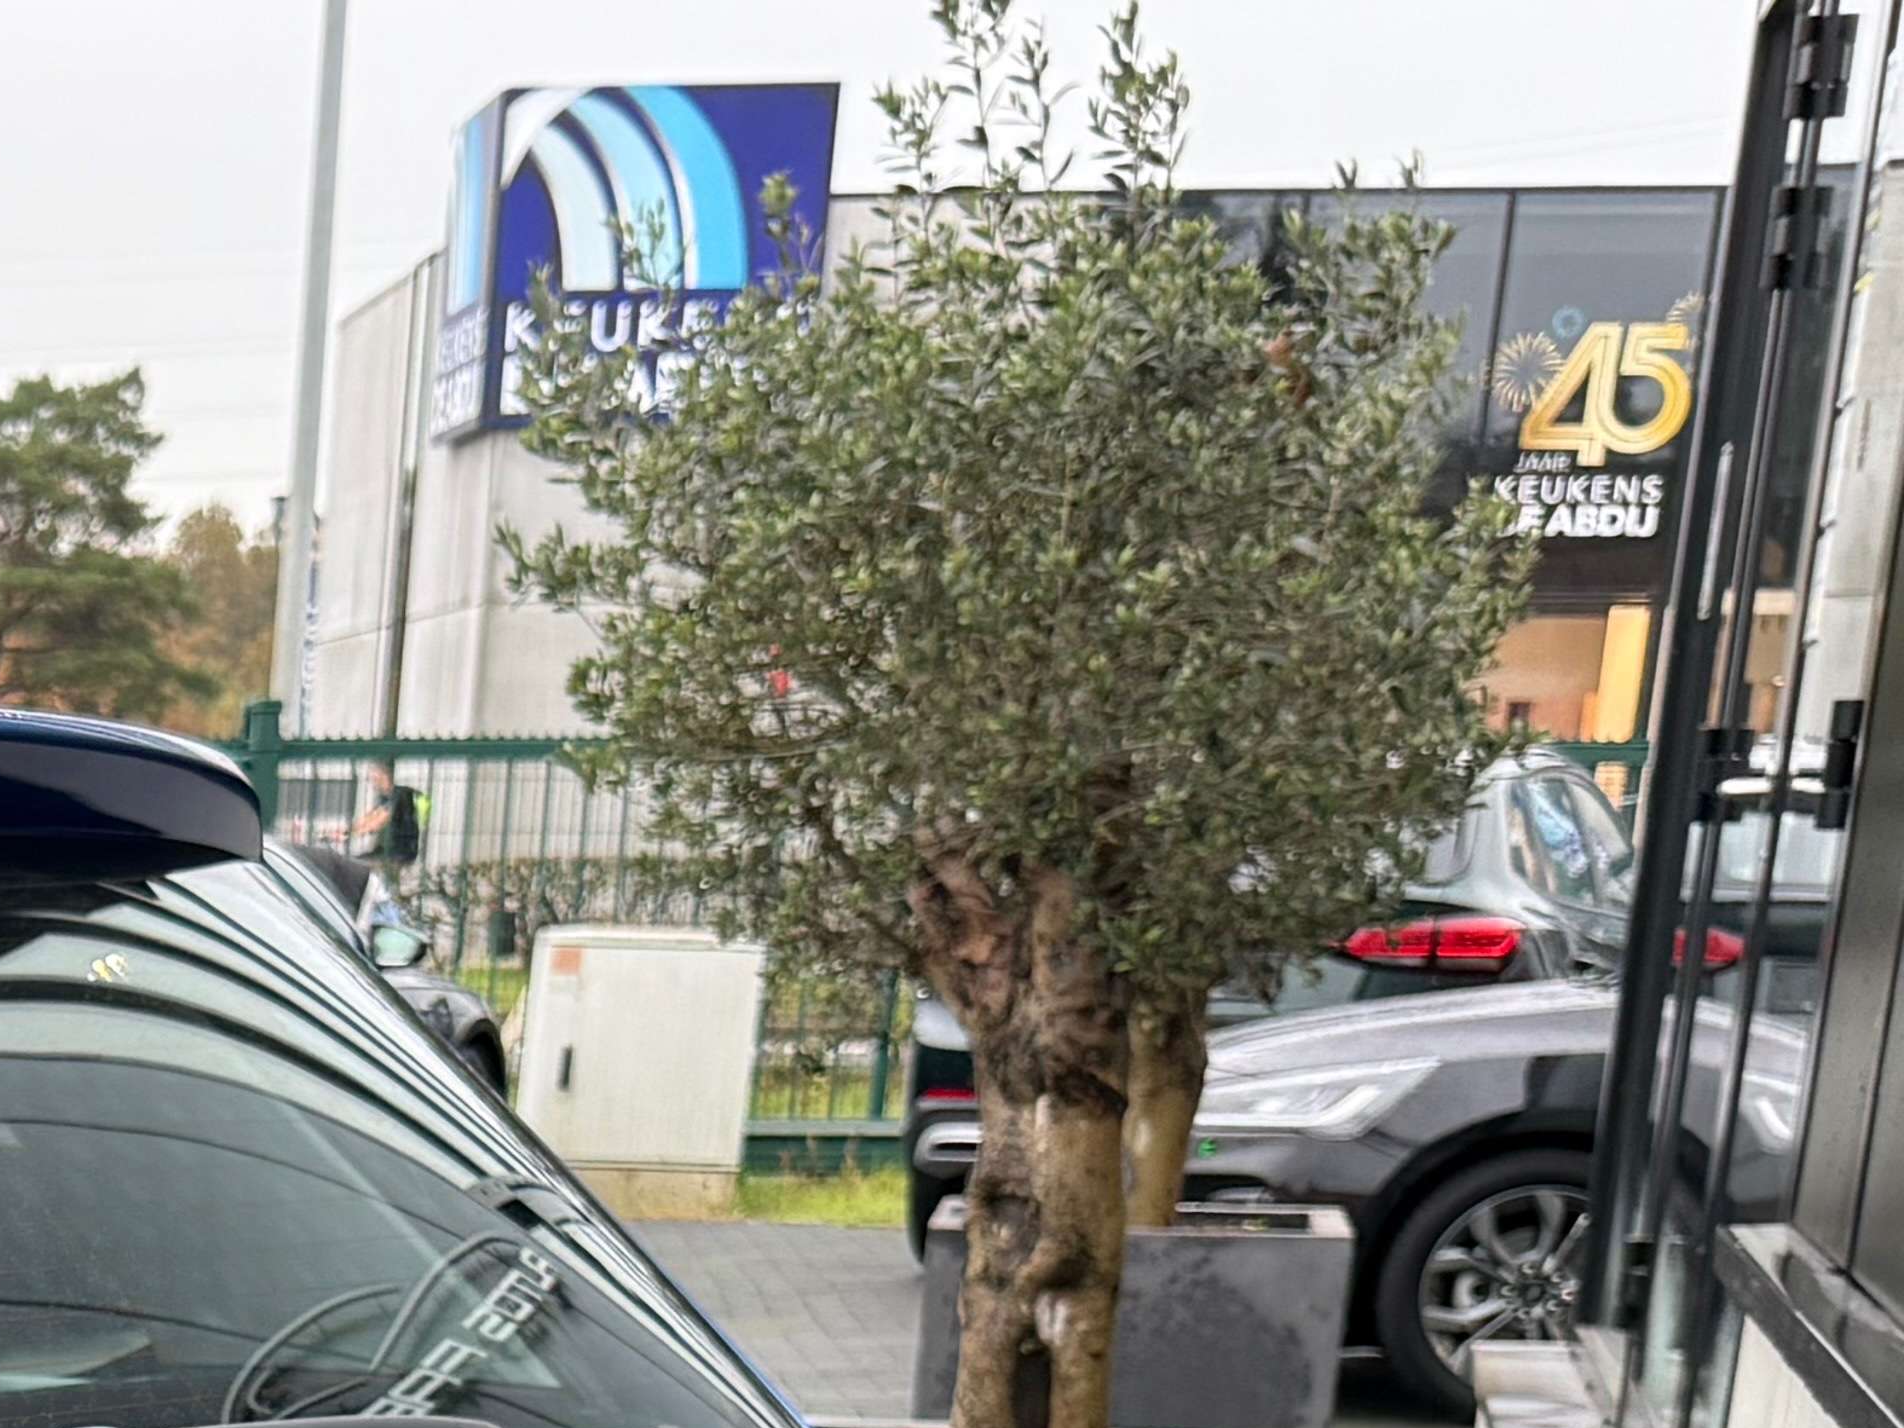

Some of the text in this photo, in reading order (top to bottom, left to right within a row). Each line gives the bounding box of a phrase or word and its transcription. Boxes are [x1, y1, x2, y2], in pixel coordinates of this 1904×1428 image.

[1519, 320, 1691, 467] 45
[1495, 474, 1664, 504] KEUKENS
[1544, 503, 1660, 537] ABDU
